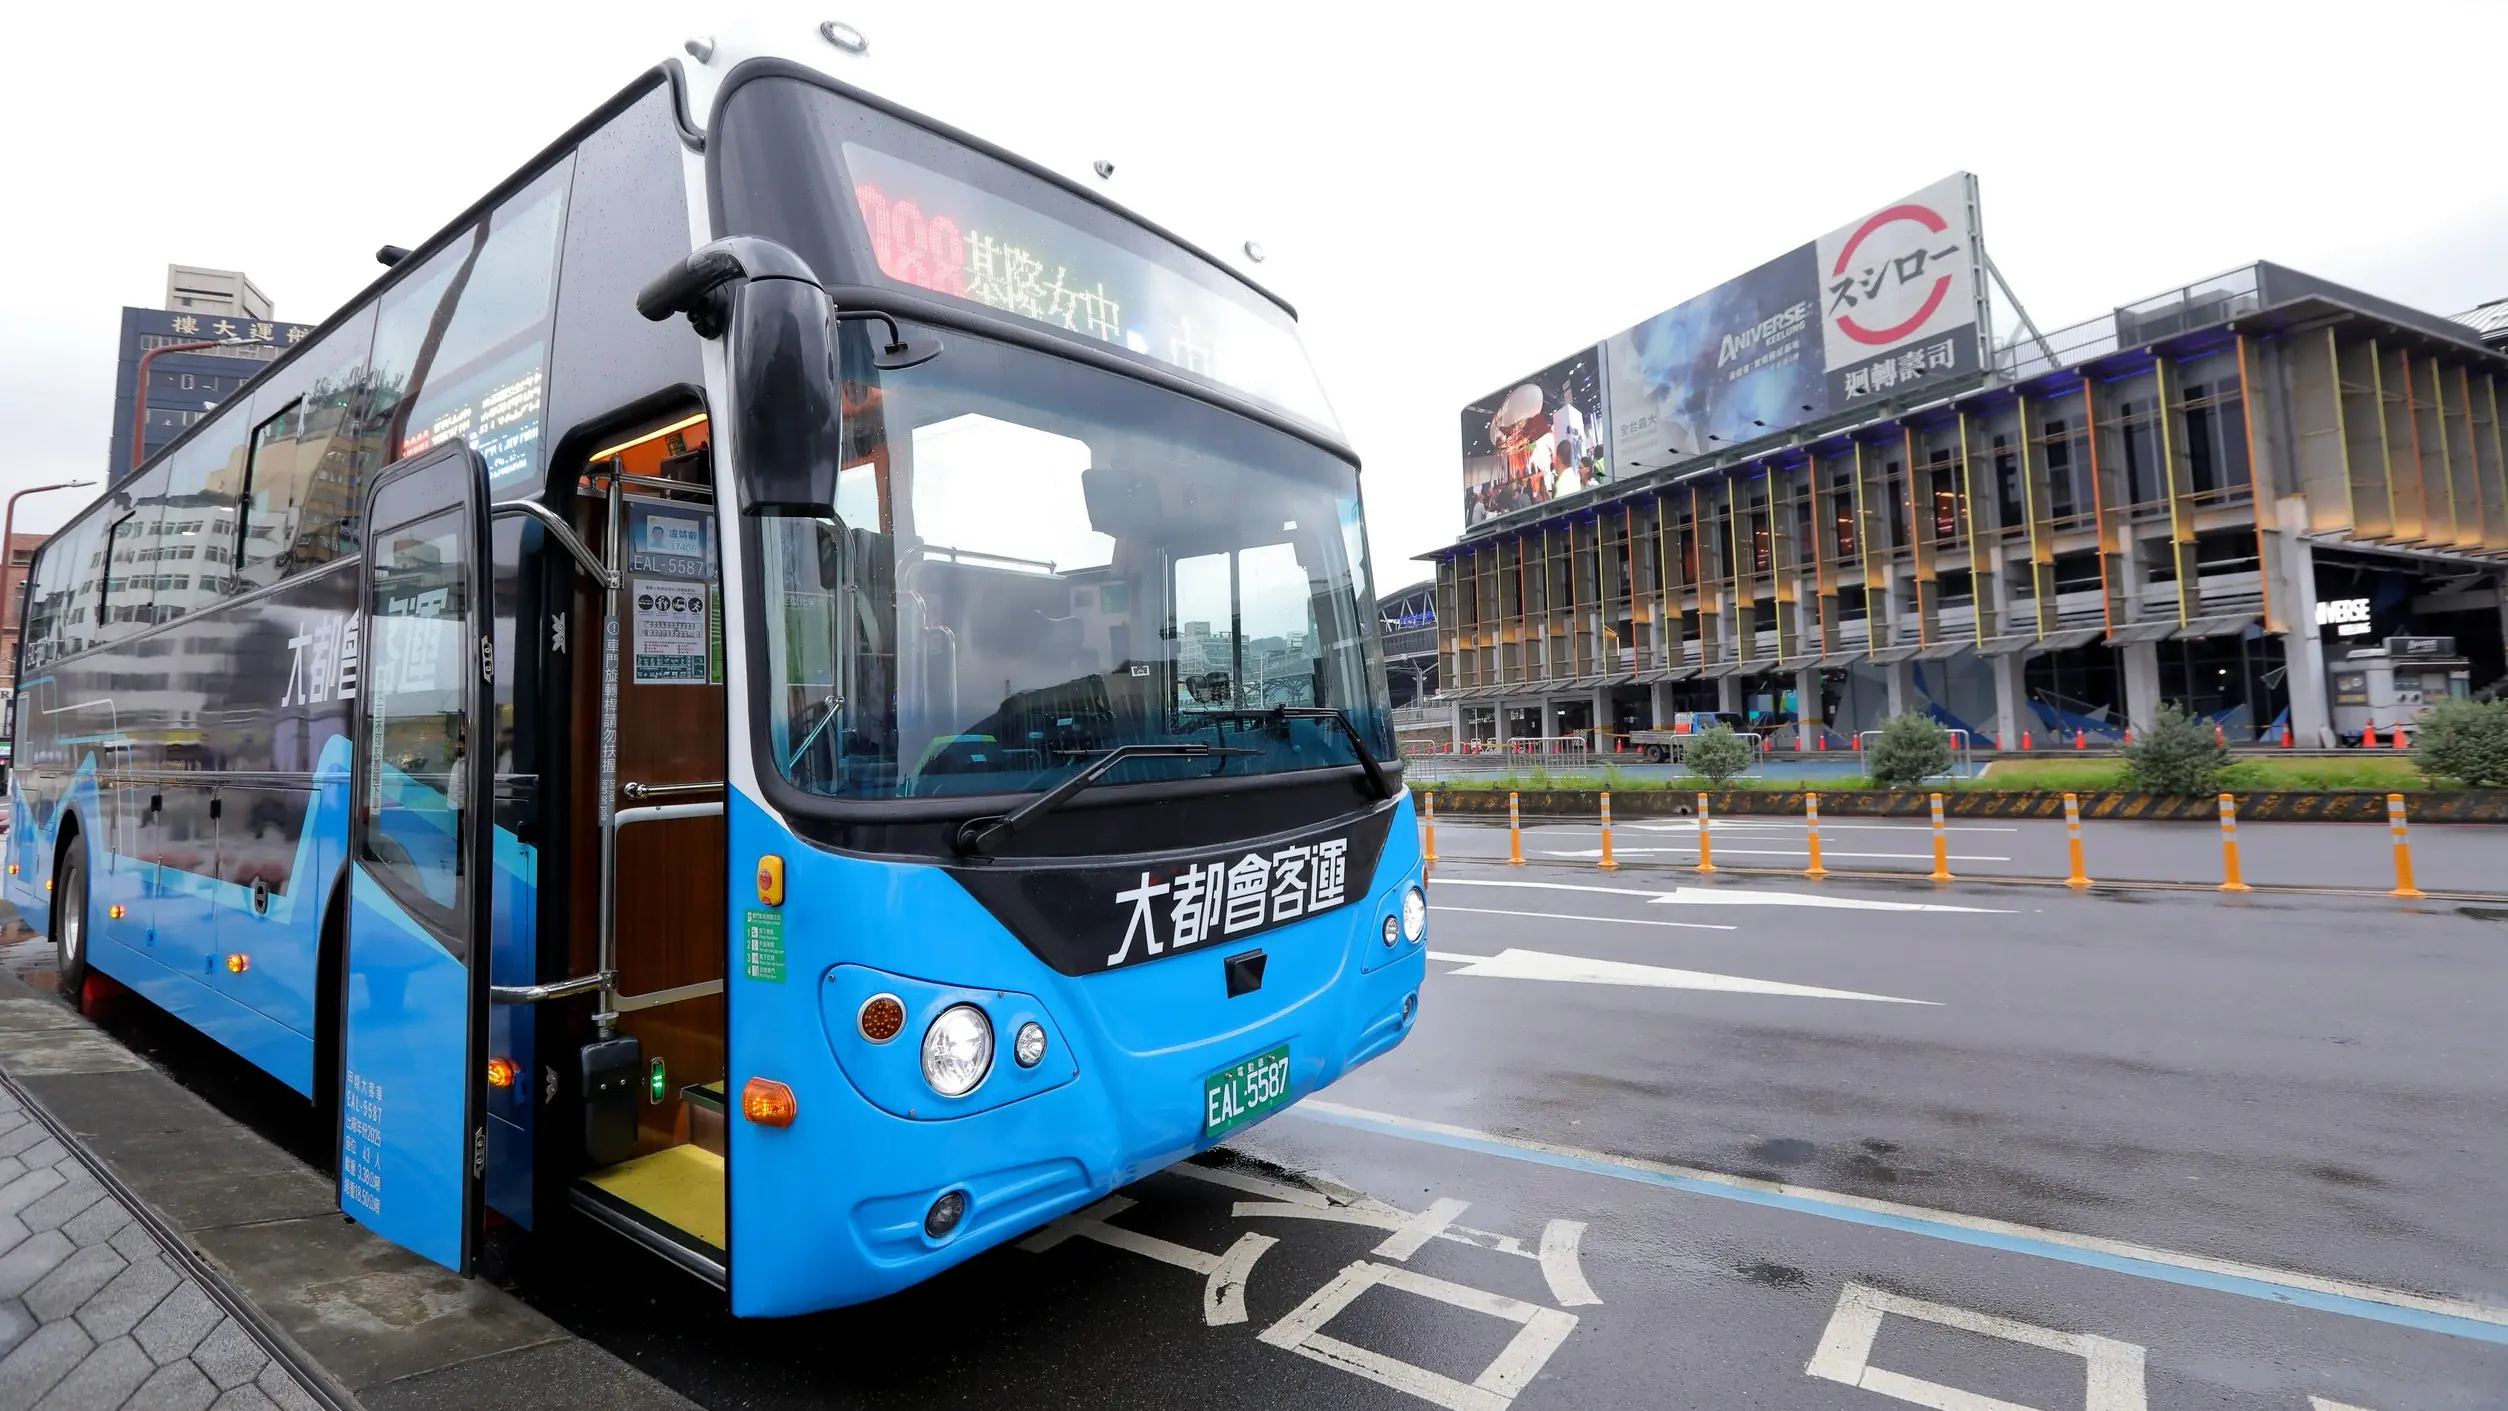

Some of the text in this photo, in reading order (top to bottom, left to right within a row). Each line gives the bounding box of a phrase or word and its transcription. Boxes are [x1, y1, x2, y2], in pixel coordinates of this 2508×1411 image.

[1827, 244, 1960, 316] スシロー
[1717, 301, 1807, 368] ANIVERSE
[1765, 320, 1806, 346] KEELUNG
[634, 555, 704, 575] EAL-5587
[1107, 837, 1348, 967] 大都會客運
